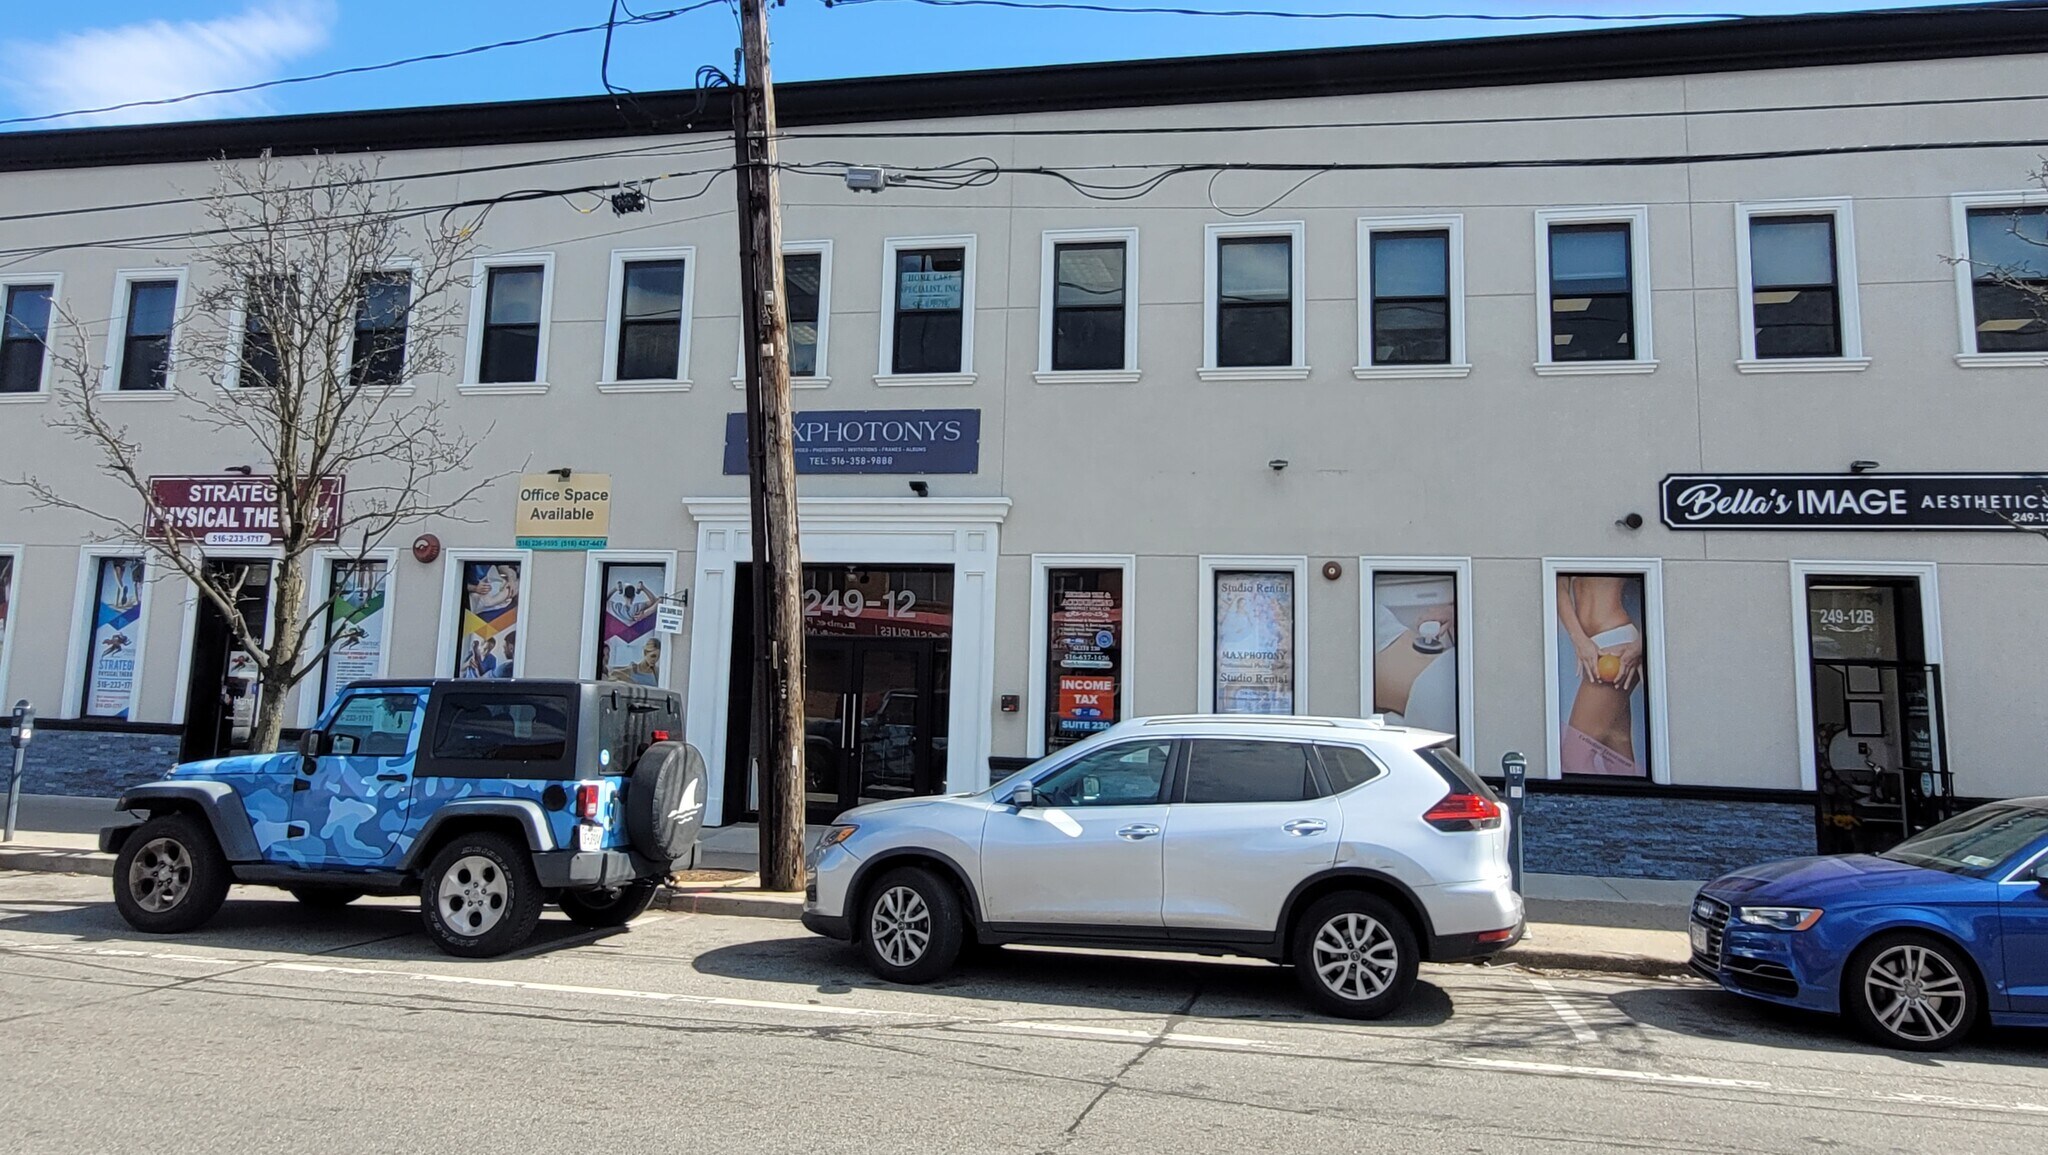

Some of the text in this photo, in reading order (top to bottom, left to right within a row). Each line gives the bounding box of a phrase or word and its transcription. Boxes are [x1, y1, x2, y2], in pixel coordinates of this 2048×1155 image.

[746, 420, 962, 443] XPHOTONYS
[809, 456, 893, 466] TEL: 516-358-9888
[520, 487, 609, 505] Office Space
[1676, 483, 1793, 521] Bella's
[1797, 489, 1908, 515] IMAGE
[529, 506, 595, 521] Available
[212, 534, 265, 544] 516-233-1717
[1220, 582, 1288, 594] Studio Rental
[803, 588, 917, 619] 249-12
[1819, 608, 1875, 625] 249-12B
[1220, 672, 1288, 684] Studio Rental
[1061, 679, 1112, 691] INCOME
[1073, 693, 1099, 705] TAX
[1061, 720, 1111, 730] SUITE 230
